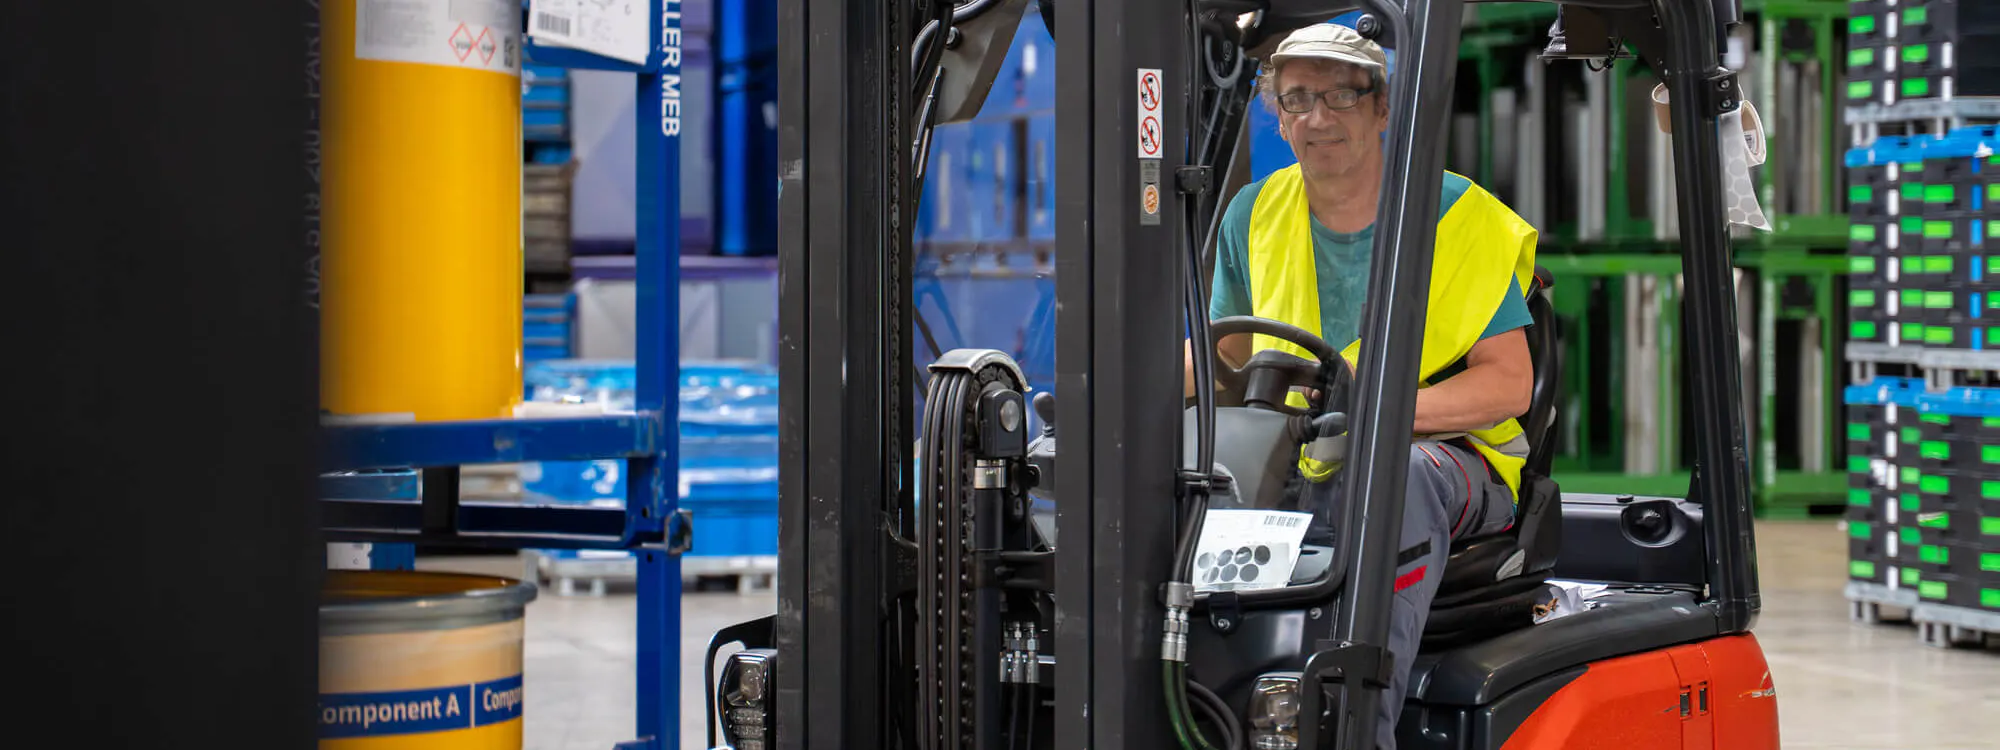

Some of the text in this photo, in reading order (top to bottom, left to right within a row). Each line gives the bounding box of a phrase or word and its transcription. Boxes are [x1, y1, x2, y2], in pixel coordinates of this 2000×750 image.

[662, 74, 681, 136] MEB
[320, 692, 461, 729] omponent A
